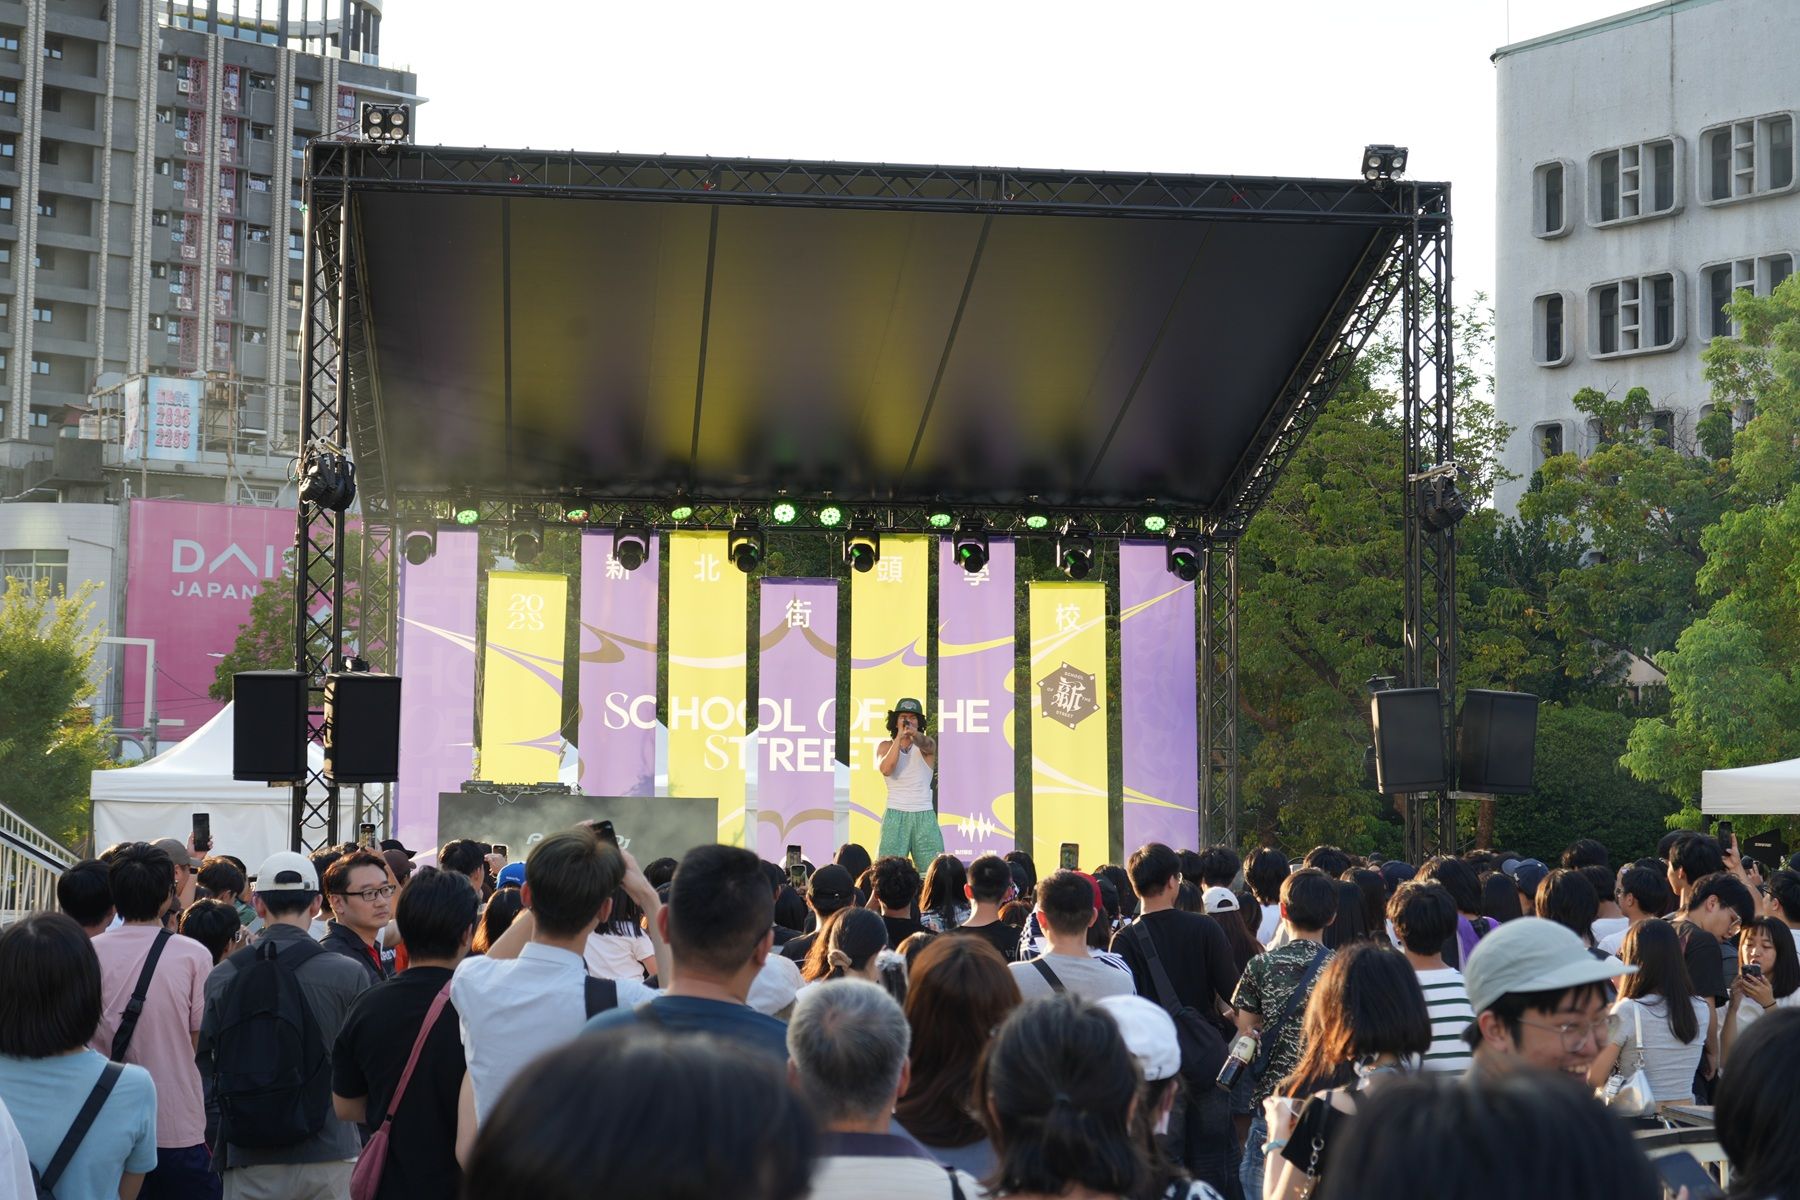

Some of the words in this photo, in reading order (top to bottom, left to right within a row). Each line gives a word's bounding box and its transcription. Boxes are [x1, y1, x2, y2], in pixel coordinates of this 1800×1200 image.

[171, 580, 258, 600] JAPAN
[693, 553, 721, 582] 北
[784, 599, 812, 628] 街
[876, 556, 903, 583] 頭
[1055, 603, 1081, 632] 校
[604, 691, 806, 732] SCHOOL
[817, 697, 886, 734] OF
[938, 699, 990, 733] HE
